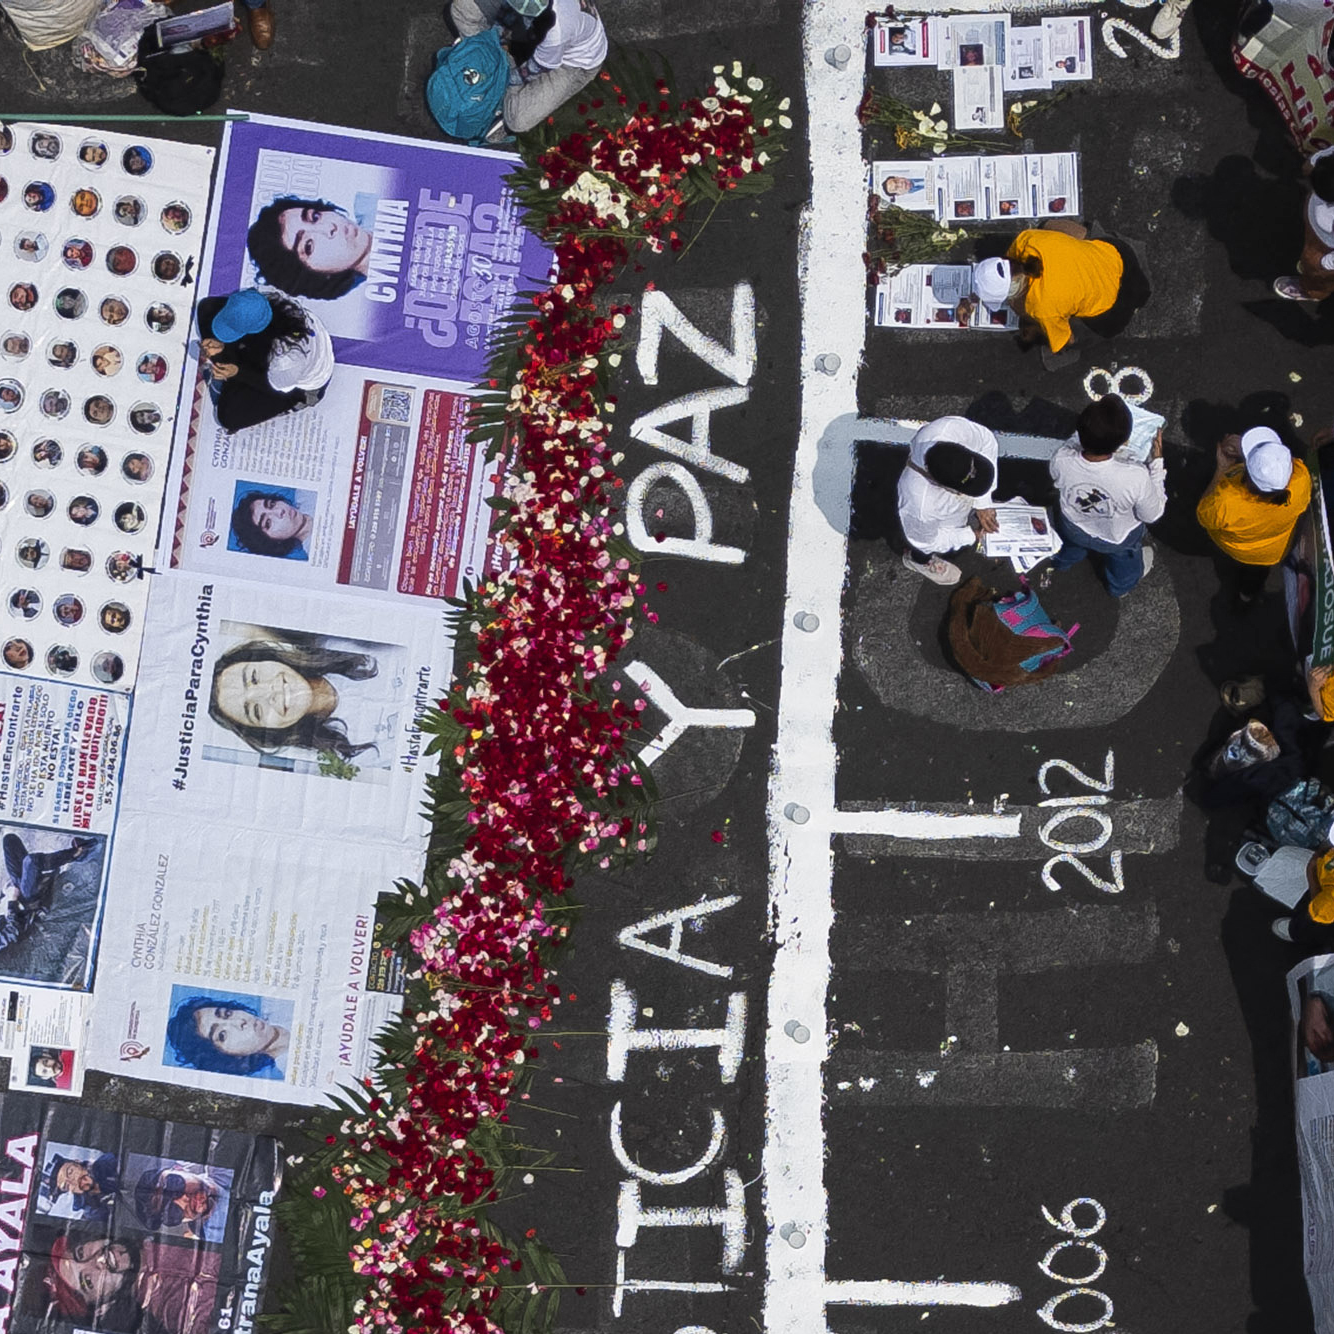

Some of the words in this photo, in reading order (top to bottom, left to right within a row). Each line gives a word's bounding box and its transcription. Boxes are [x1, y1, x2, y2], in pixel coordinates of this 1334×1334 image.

[364, 196, 409, 303] CYNTHIA
[470, 254, 495, 279] 30
[464, 278, 487, 348] AGOSTO
[625, 277, 757, 563] PAZ
[171, 583, 216, 791] #JusticiaParaCynthia
[624, 660, 755, 766] Y
[1039, 750, 1126, 891] 2012
[130, 921, 147, 967] CYNTHIA
[142, 913, 162, 970] GONZÁLEZ
[348, 913, 369, 975] VOLVER!
[217, 1306, 232, 1329] 61
